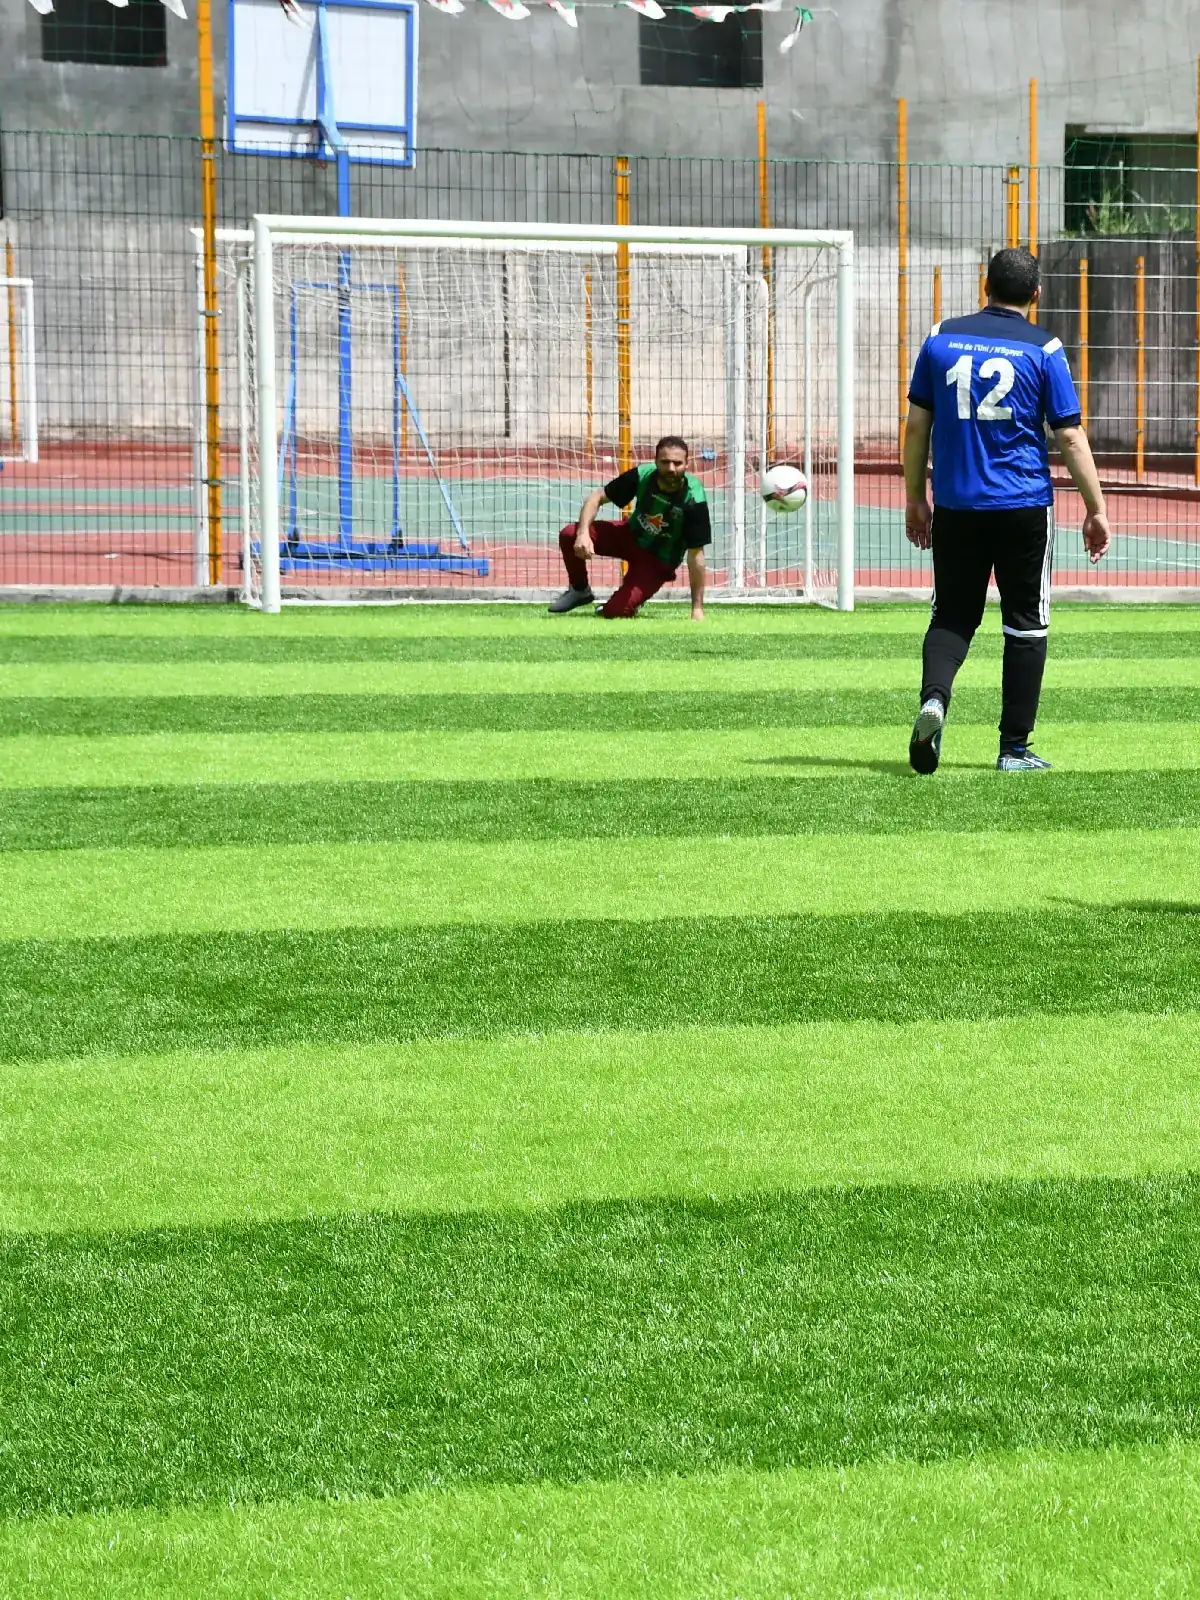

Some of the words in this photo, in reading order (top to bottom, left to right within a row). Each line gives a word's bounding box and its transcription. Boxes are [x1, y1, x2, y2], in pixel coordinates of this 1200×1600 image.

[948, 341, 963, 349] Amis
[964, 343, 974, 351] de
[945, 354, 1015, 421] 12
